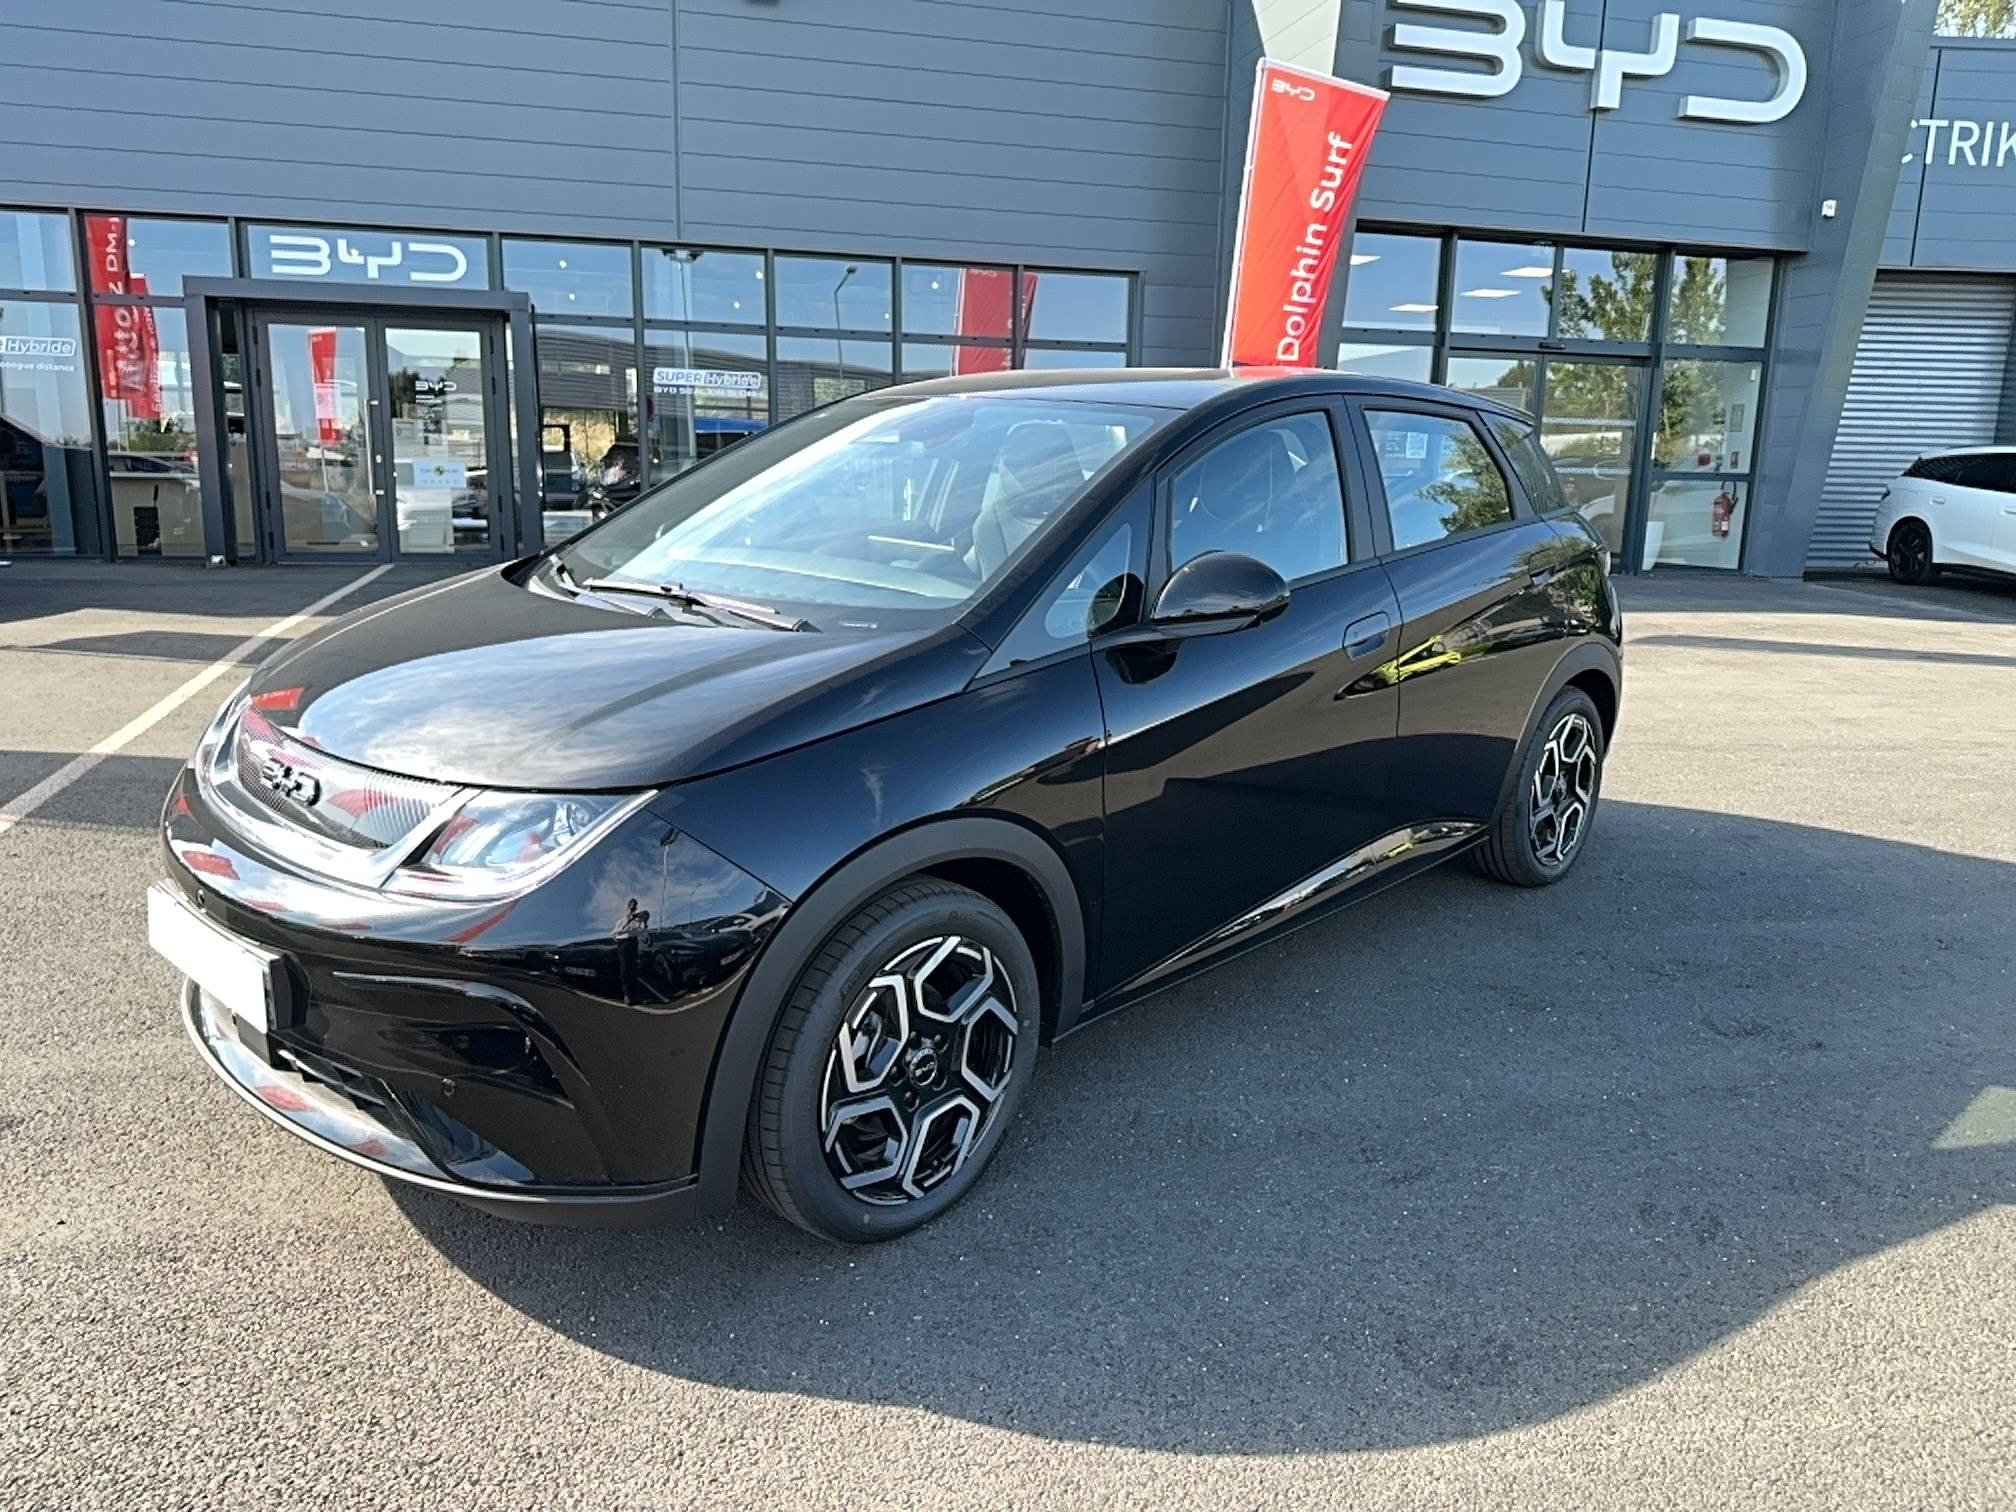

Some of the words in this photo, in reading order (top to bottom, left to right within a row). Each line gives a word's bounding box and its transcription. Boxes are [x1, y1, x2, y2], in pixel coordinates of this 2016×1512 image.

[1387, 0, 1807, 123] BYD
[1271, 78, 1316, 101] BYD
[269, 235, 468, 281] BYD
[1276, 223, 1329, 362] Dolphin
[1310, 131, 1353, 213] Surf
[7, 339, 72, 353] Hybride
[416, 381, 457, 391] BYD
[657, 371, 703, 385] SUPER
[261, 757, 321, 807] BYD
